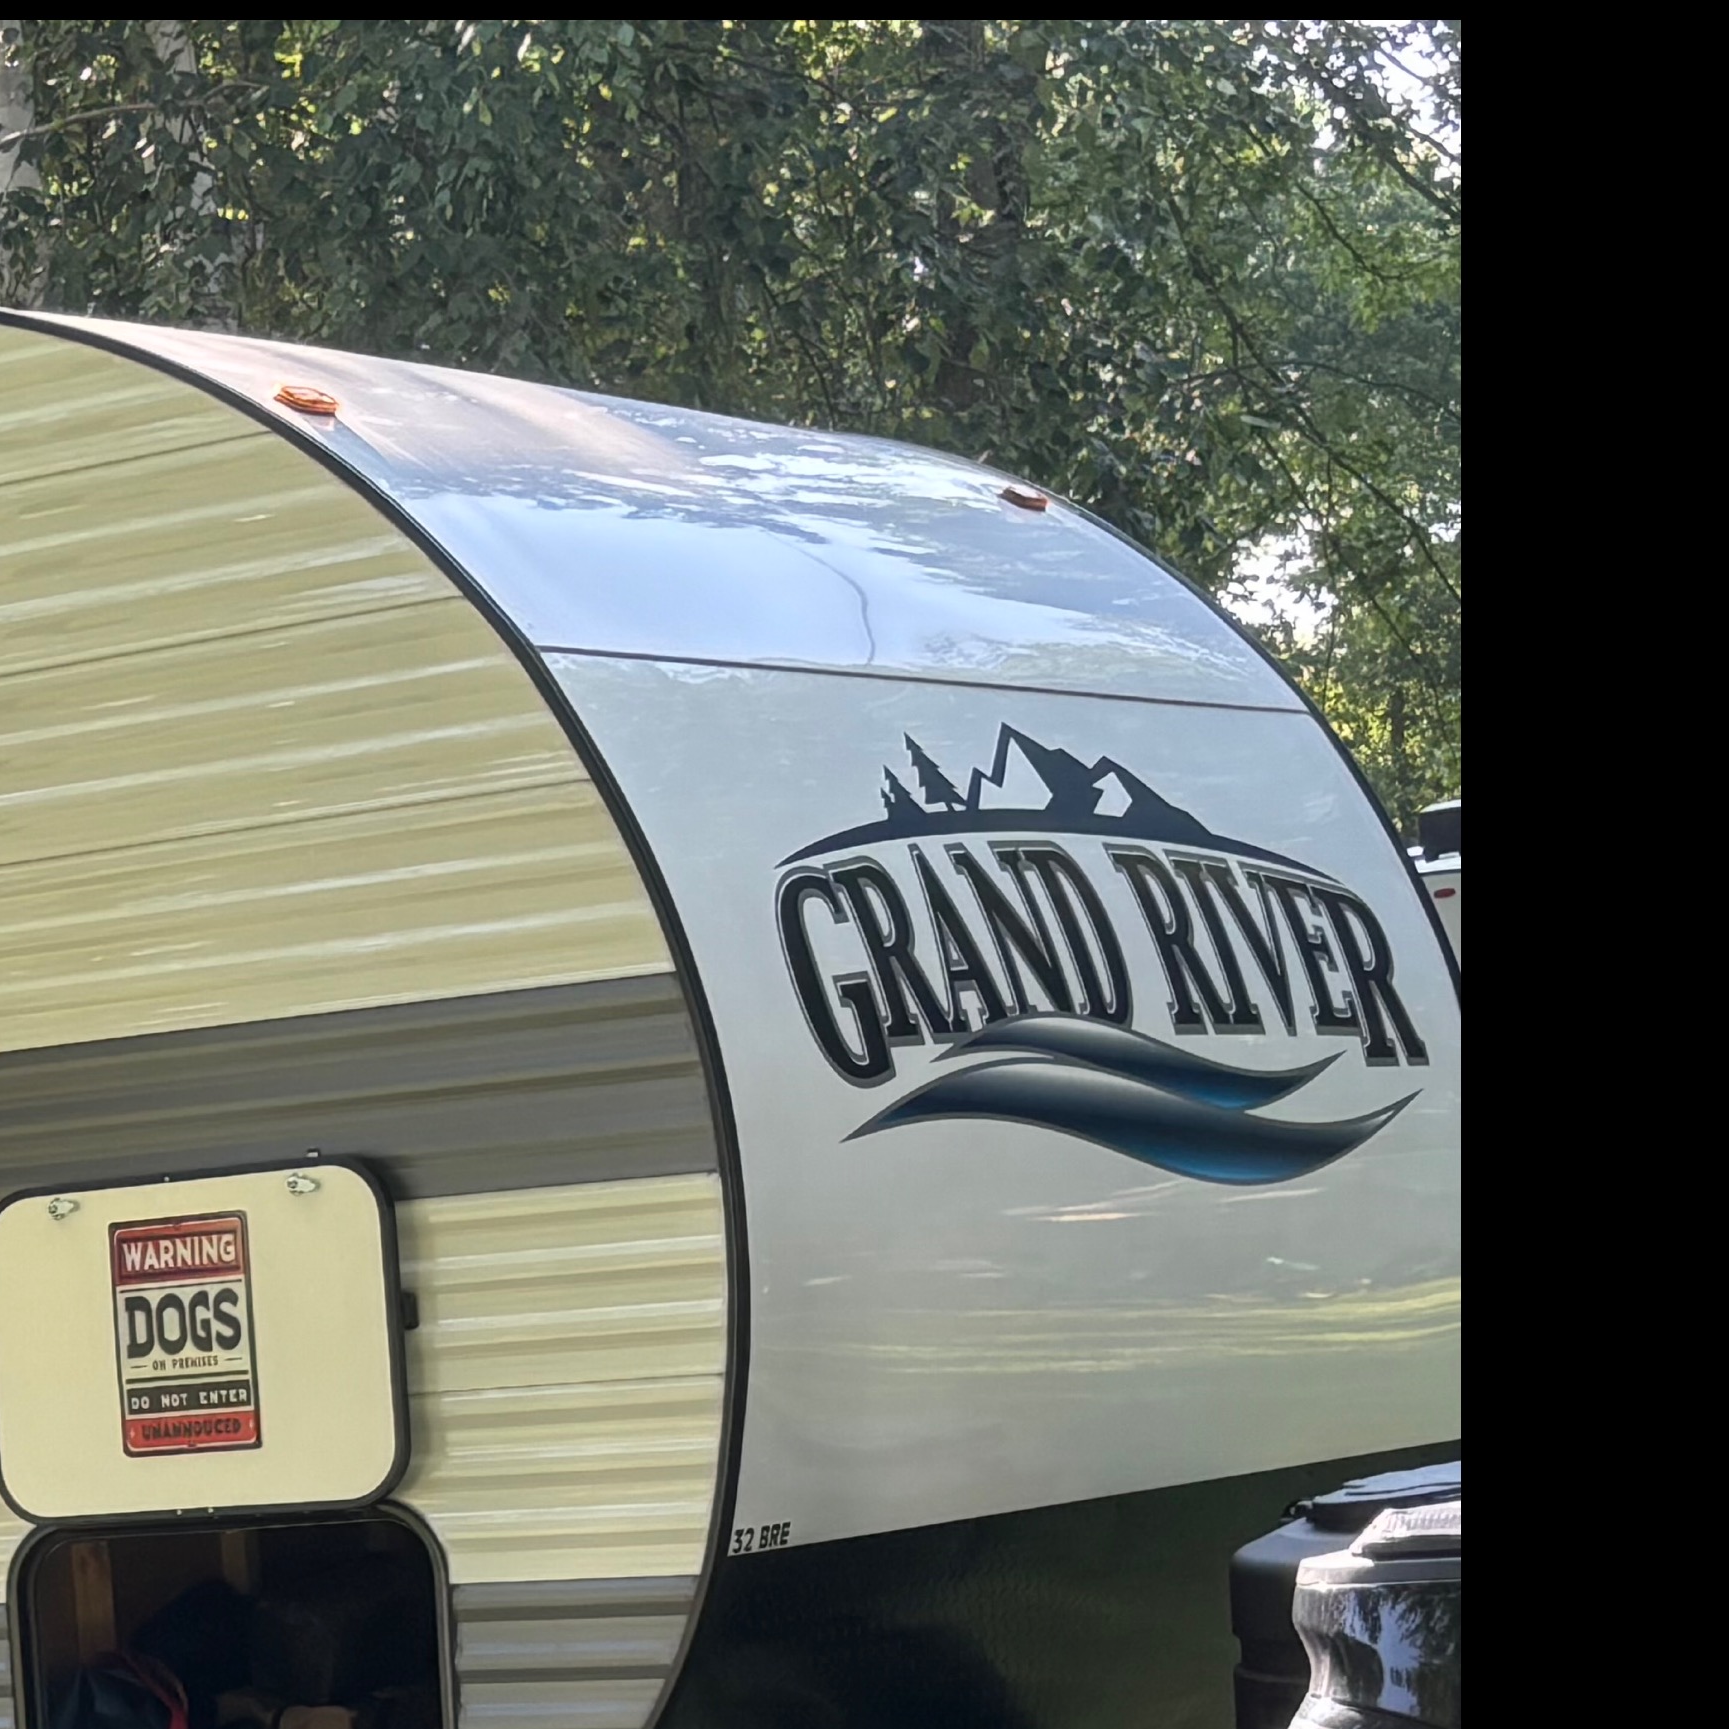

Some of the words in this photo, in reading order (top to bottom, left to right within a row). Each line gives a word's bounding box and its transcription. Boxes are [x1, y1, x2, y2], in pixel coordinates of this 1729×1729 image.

[774, 841, 1134, 1089] GRAND
[1102, 842, 1430, 1067] RIVER
[122, 1233, 236, 1272] WARNING
[125, 1288, 242, 1359] DOGS
[152, 1360, 167, 1371] ON
[172, 1355, 219, 1369] PREMISES
[131, 1396, 150, 1409] DO
[161, 1393, 188, 1408] NOT
[199, 1389, 248, 1405] ENTER
[732, 1527, 755, 1554] 32
[759, 1521, 791, 1549] BRE
